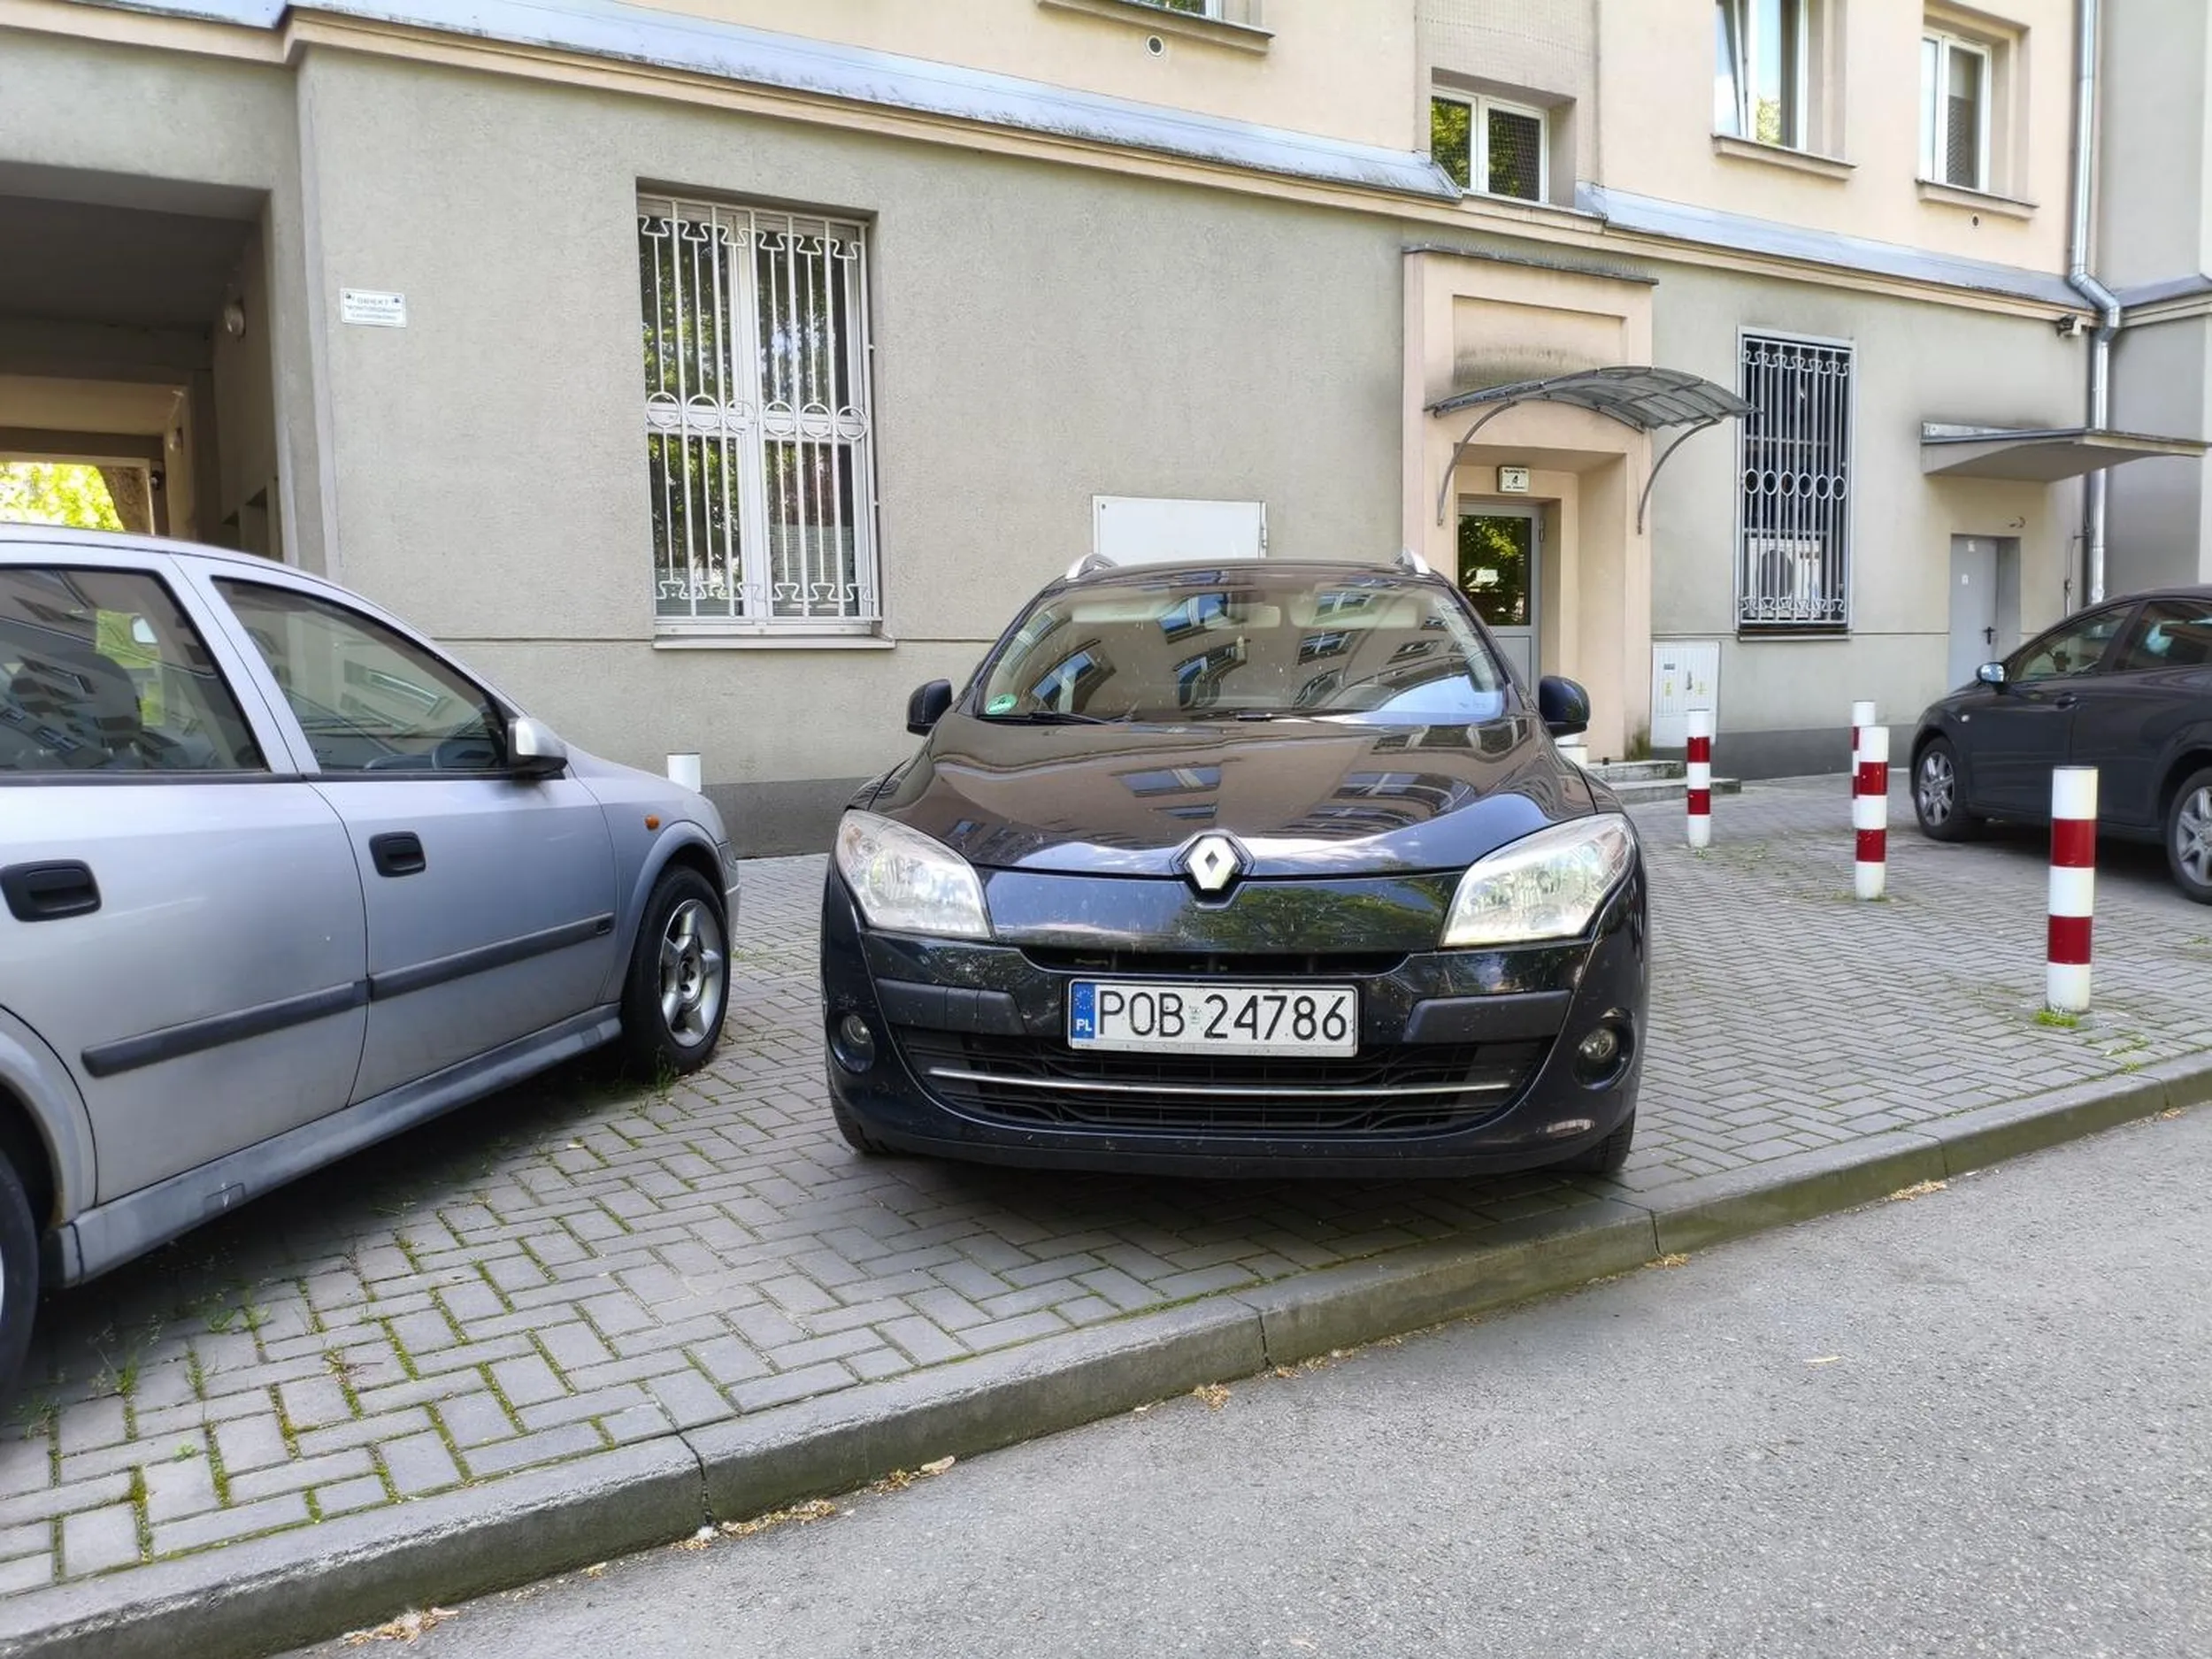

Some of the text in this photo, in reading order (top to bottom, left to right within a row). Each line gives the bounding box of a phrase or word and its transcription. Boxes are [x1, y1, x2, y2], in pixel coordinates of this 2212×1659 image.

[1076, 1018, 1093, 1032] PL
[1099, 989, 1347, 1041] POB 24786
